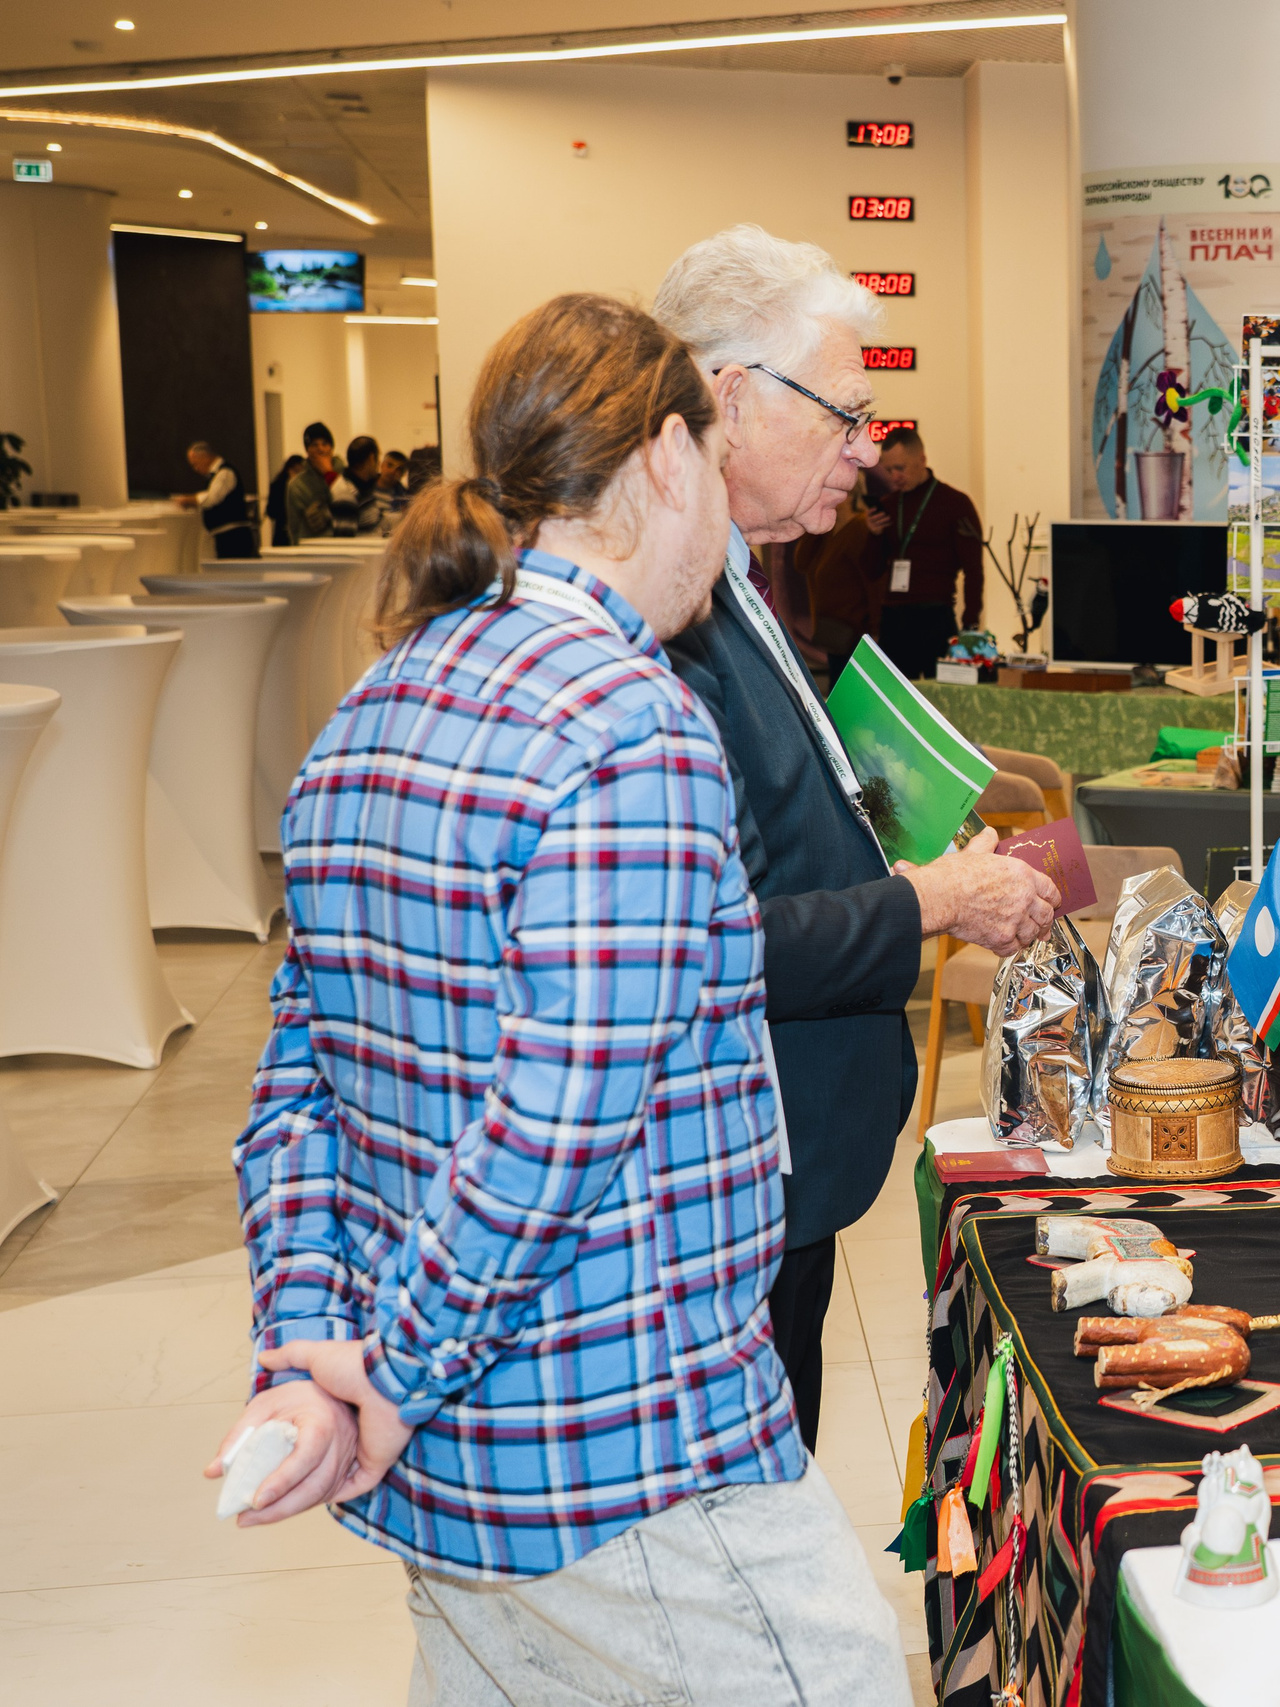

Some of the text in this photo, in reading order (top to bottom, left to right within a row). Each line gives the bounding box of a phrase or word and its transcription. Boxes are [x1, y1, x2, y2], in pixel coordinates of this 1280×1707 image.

[857, 123, 911, 145] 17:08
[850, 197, 911, 219] 03:08
[1190, 226, 1273, 241] ВЕСЕННИЙ
[1190, 244, 1273, 261] ПЛАЧ
[738, 581, 765, 621] ОБЩЕСТВО
[762, 620, 783, 651] ОХРАНЫ
